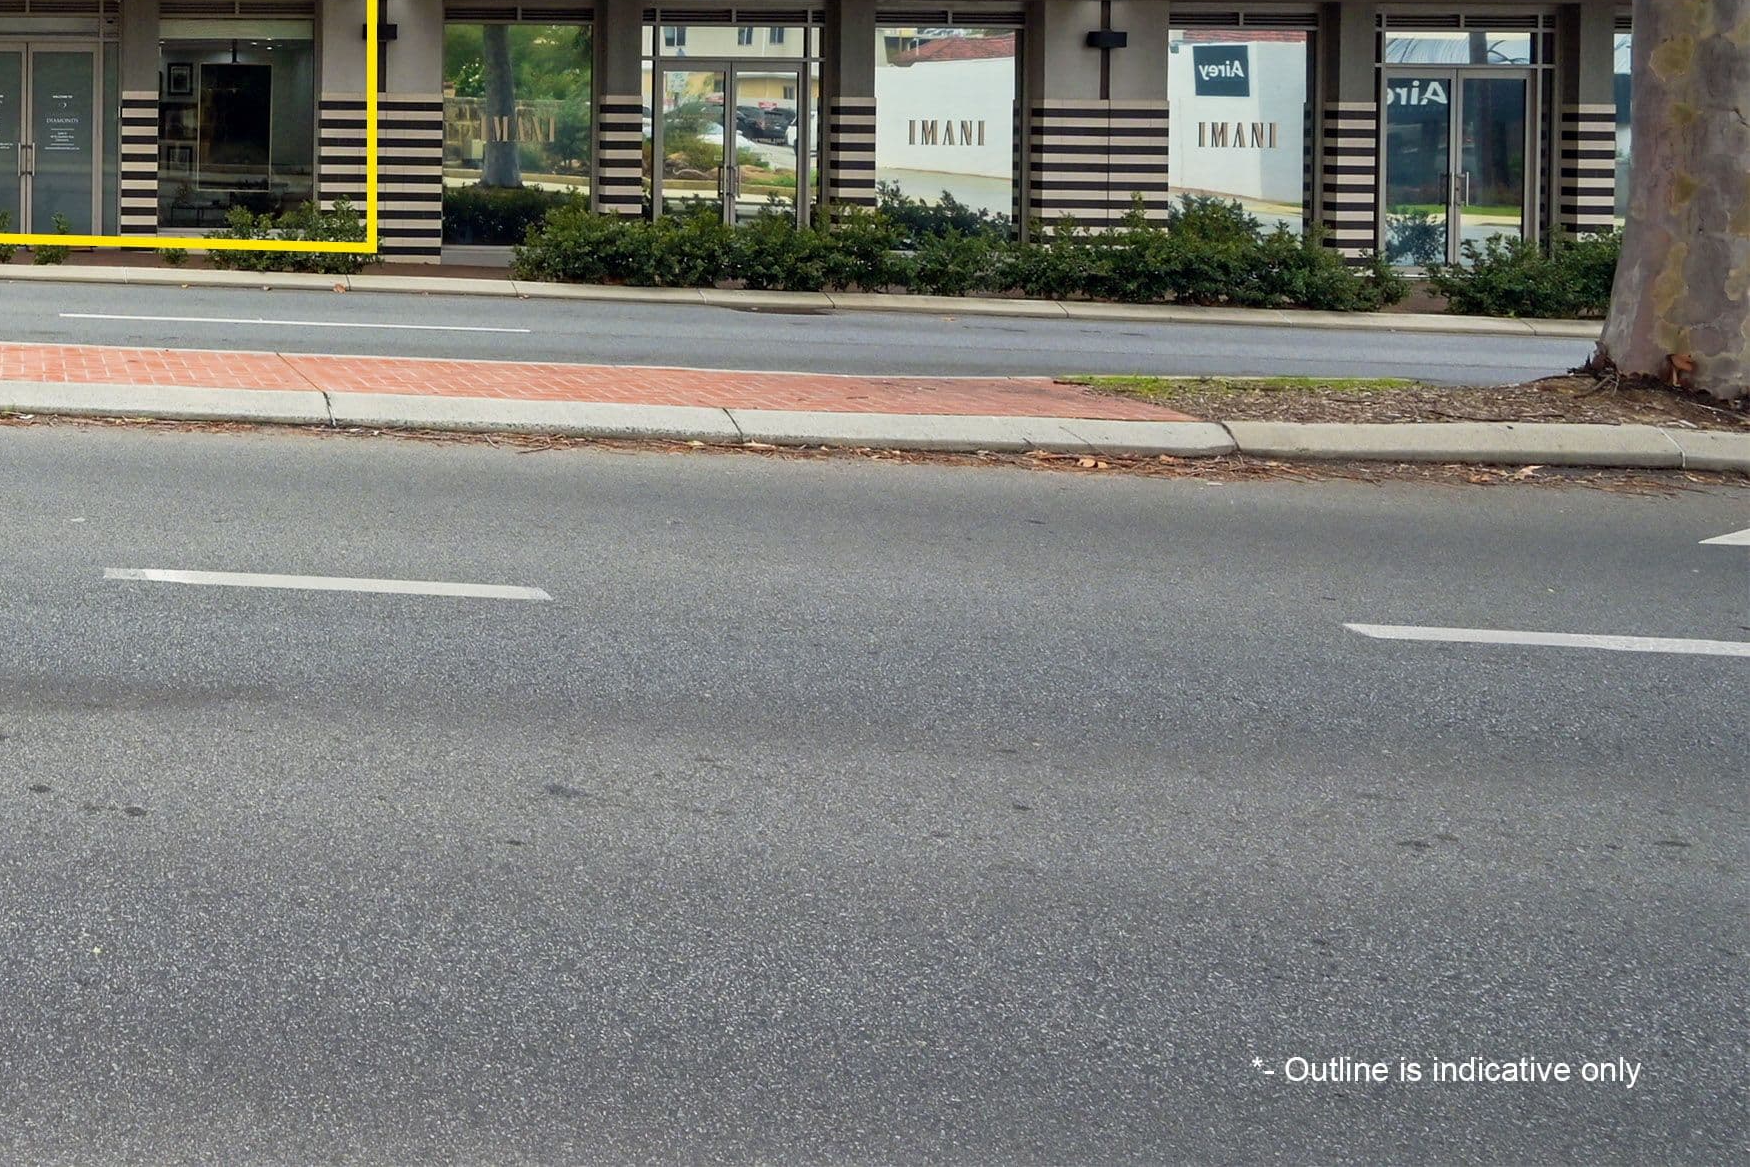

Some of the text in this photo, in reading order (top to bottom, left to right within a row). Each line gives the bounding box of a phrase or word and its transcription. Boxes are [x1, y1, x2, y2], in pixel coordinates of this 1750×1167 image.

[481, 115, 555, 142] IMANI
[909, 120, 985, 146] IMANI
[1198, 122, 1276, 148] IMANI
